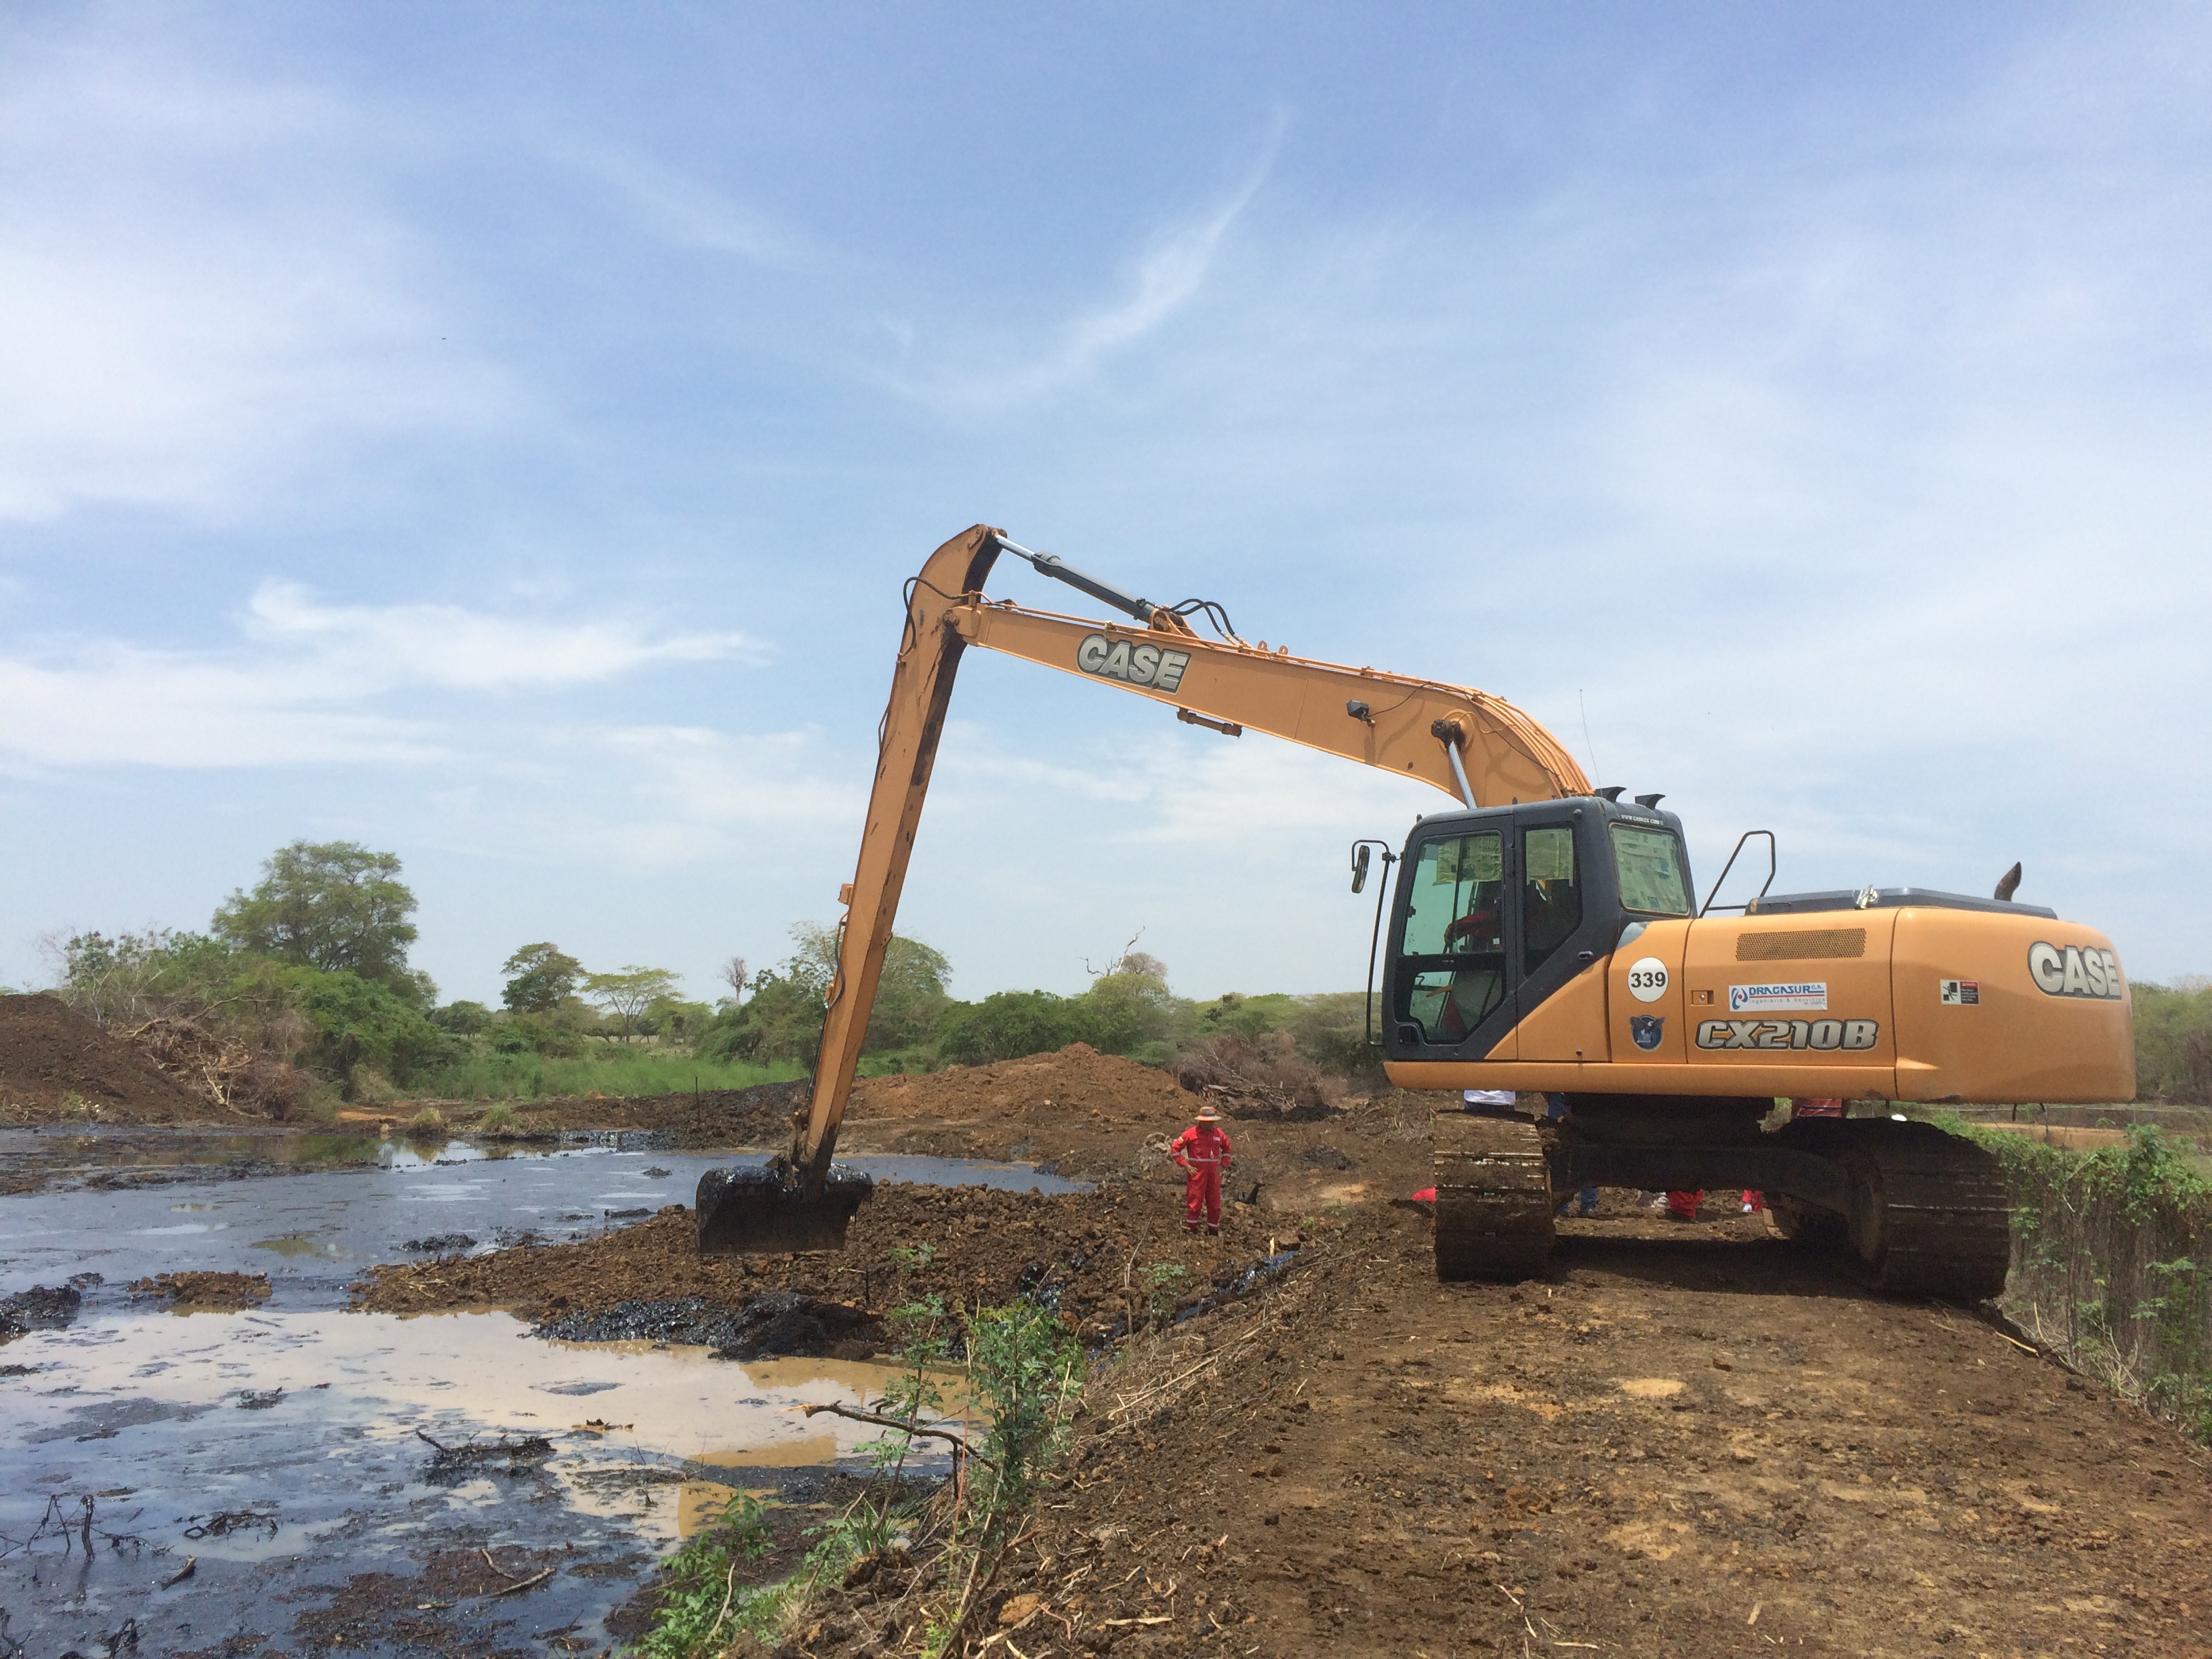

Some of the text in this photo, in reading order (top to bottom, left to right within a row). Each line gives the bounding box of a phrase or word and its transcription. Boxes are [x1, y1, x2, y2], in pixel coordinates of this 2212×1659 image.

[1078, 634, 1190, 692] CASE
[1631, 971, 1666, 988] 339
[2028, 941, 2121, 998] CASE
[1749, 985, 1810, 995] DRAGASUR
[1697, 1020, 1878, 1049] CX210B
